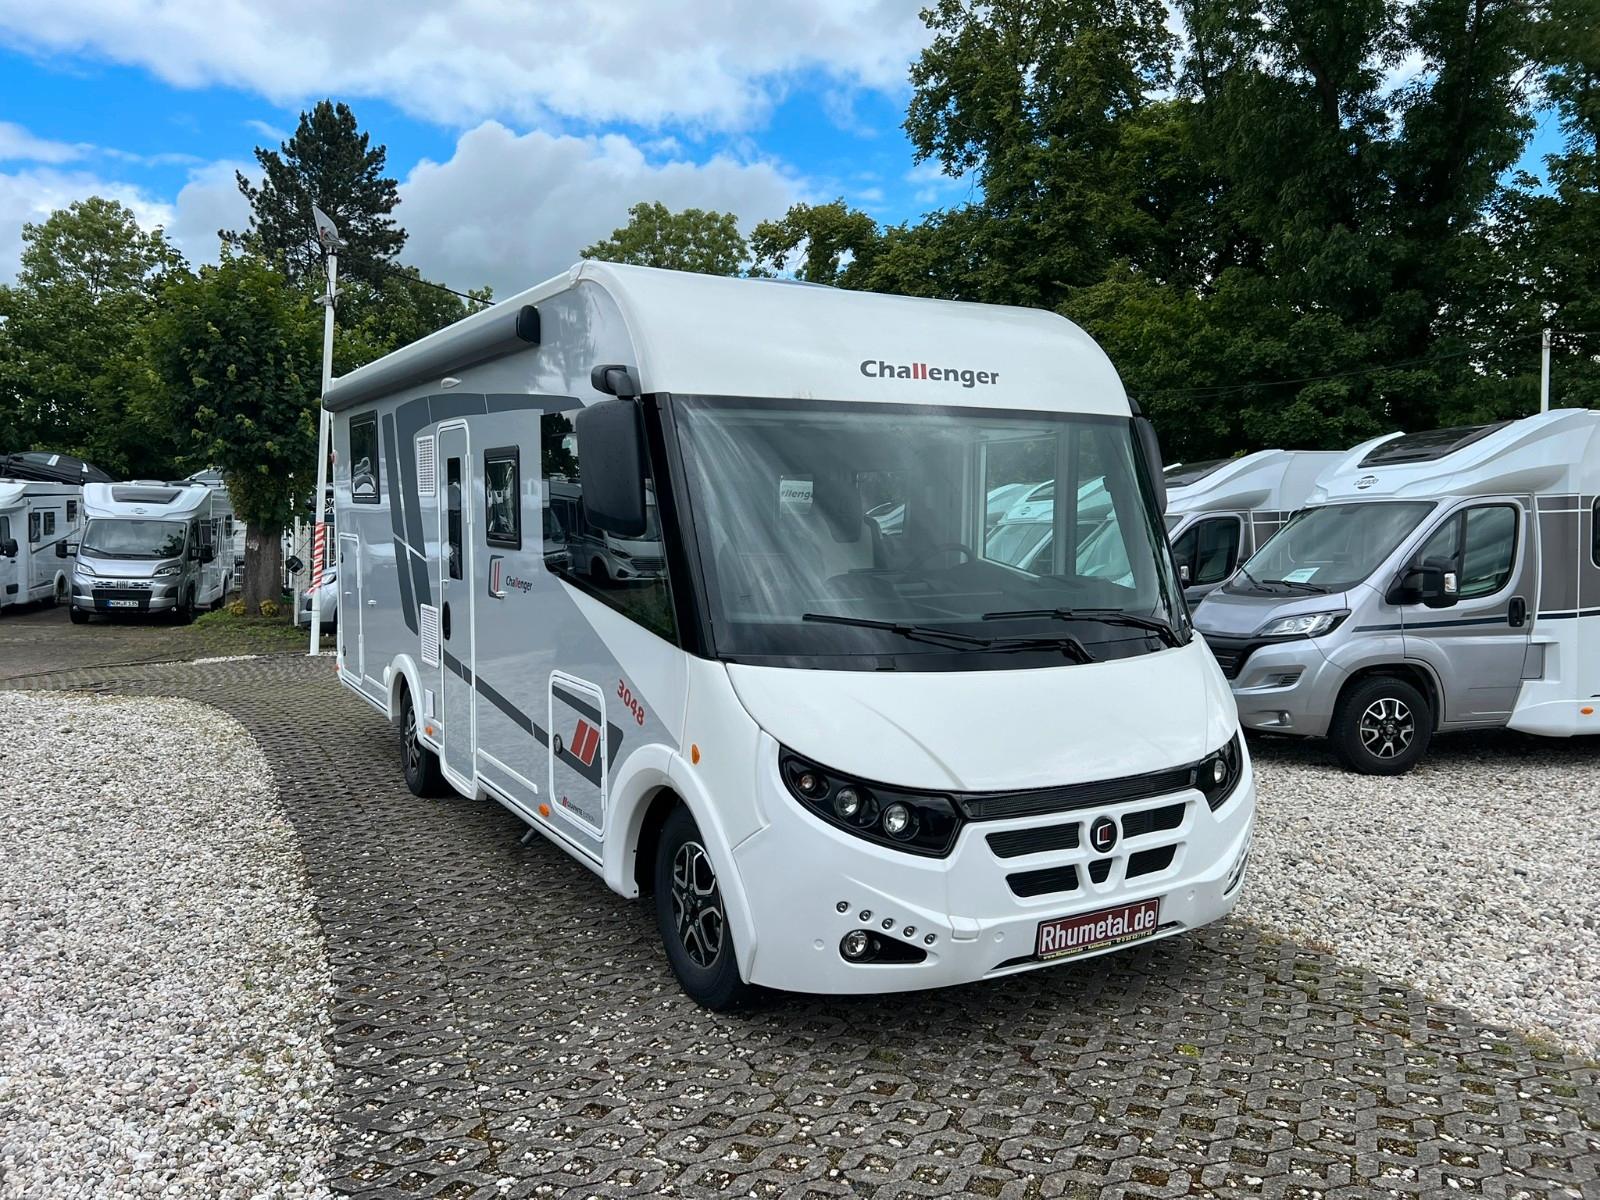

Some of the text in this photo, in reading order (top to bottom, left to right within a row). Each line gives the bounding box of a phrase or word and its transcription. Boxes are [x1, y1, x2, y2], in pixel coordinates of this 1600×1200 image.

[860, 360, 999, 388] Challenger
[505, 575, 533, 594] Challenger
[617, 679, 645, 726] 3048
[1041, 905, 1155, 952] Rhumetal.de
